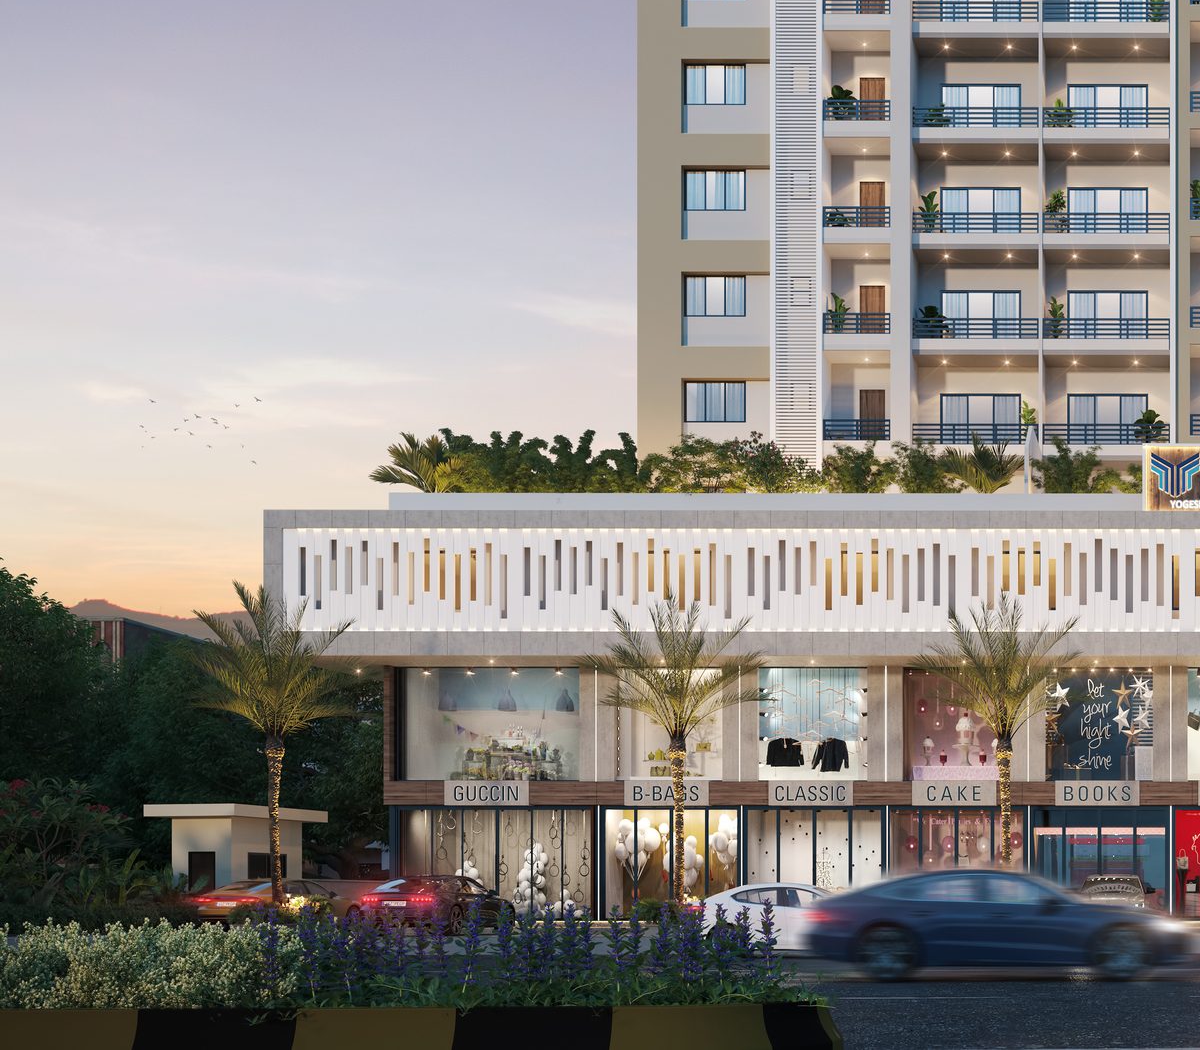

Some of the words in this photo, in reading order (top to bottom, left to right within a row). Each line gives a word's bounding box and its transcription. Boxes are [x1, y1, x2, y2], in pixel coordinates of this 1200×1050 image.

[1087, 678, 1105, 699] let
[1082, 700, 1112, 723] your
[1078, 748, 1112, 770] shine
[453, 785, 520, 802] GUCCIN
[774, 785, 846, 802] CLASSIC
[926, 785, 982, 802] CAKE
[1063, 785, 1132, 802] BOOKS
